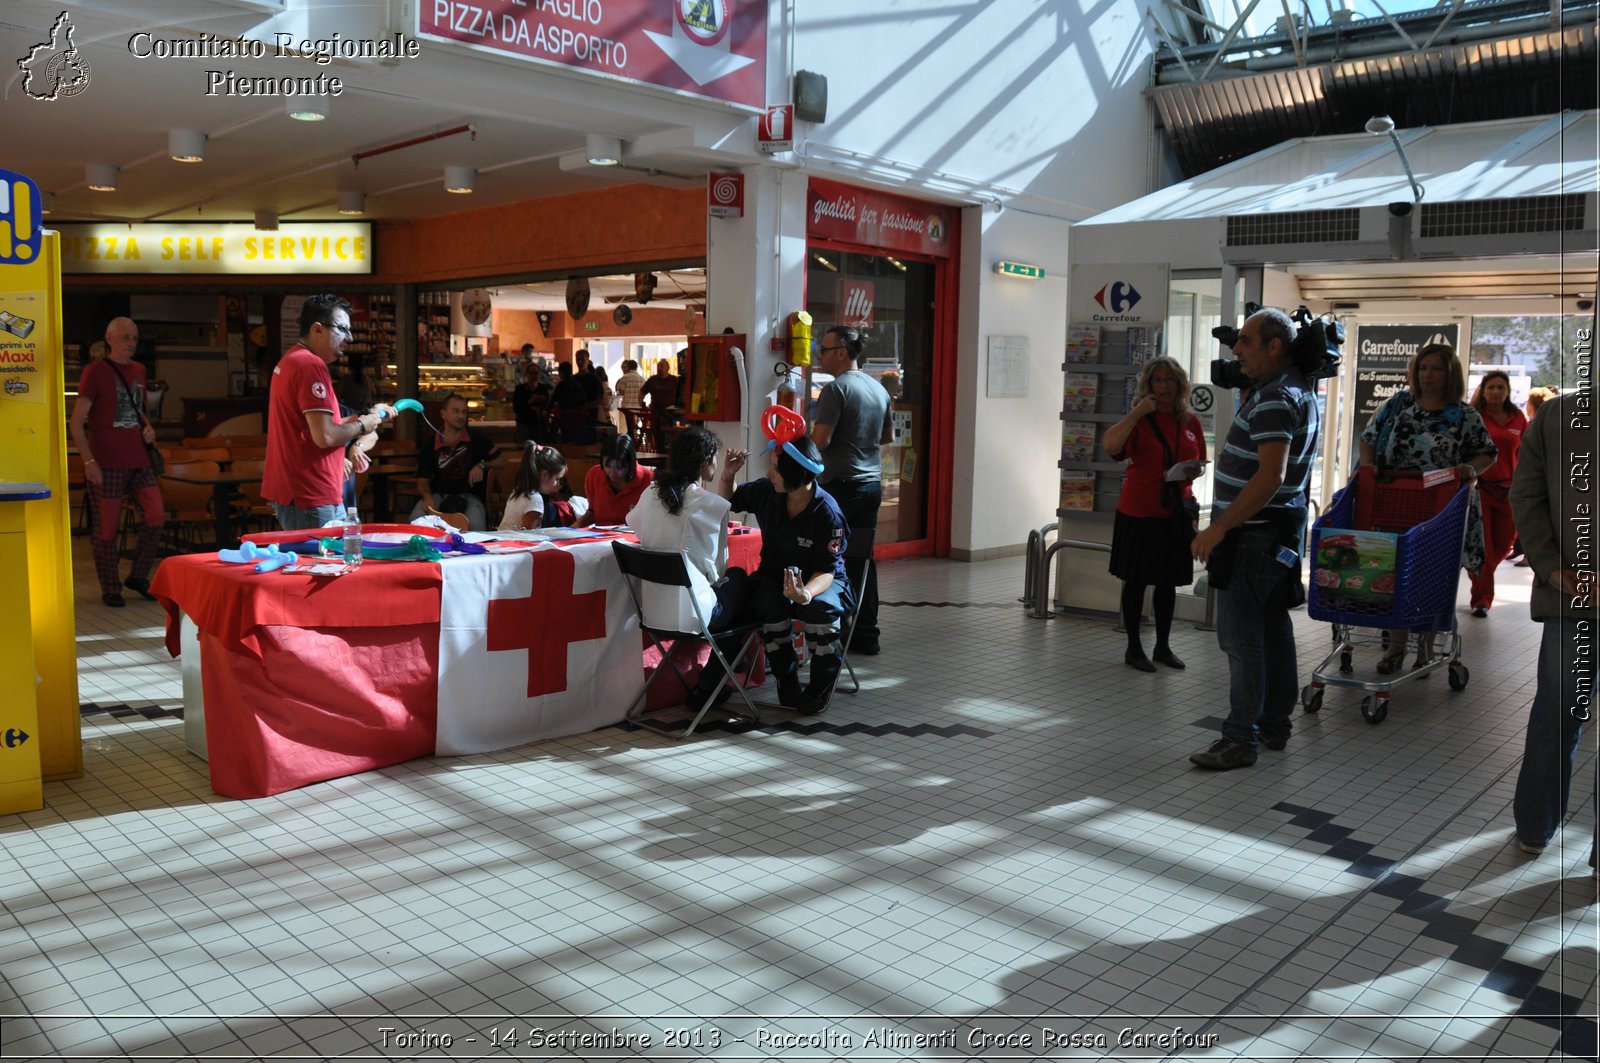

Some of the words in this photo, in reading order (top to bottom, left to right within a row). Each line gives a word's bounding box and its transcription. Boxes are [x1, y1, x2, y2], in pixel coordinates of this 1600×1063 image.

[434, 0, 497, 40] PIZZA
[502, 14, 531, 49] DA
[533, 23, 627, 69] ASPORTO
[814, 195, 856, 224] qualità
[858, 204, 877, 229] per
[880, 209, 924, 233] passione
[62, 237, 141, 260] PIZZA
[161, 237, 224, 260] SELF
[244, 237, 366, 260] SERVICE
[844, 288, 873, 320] illy
[1361, 339, 1419, 355] Carrefour
[1359, 373, 1370, 381] Dal
[1370, 371, 1376, 381] 5
[1375, 373, 1407, 382] settembre,
